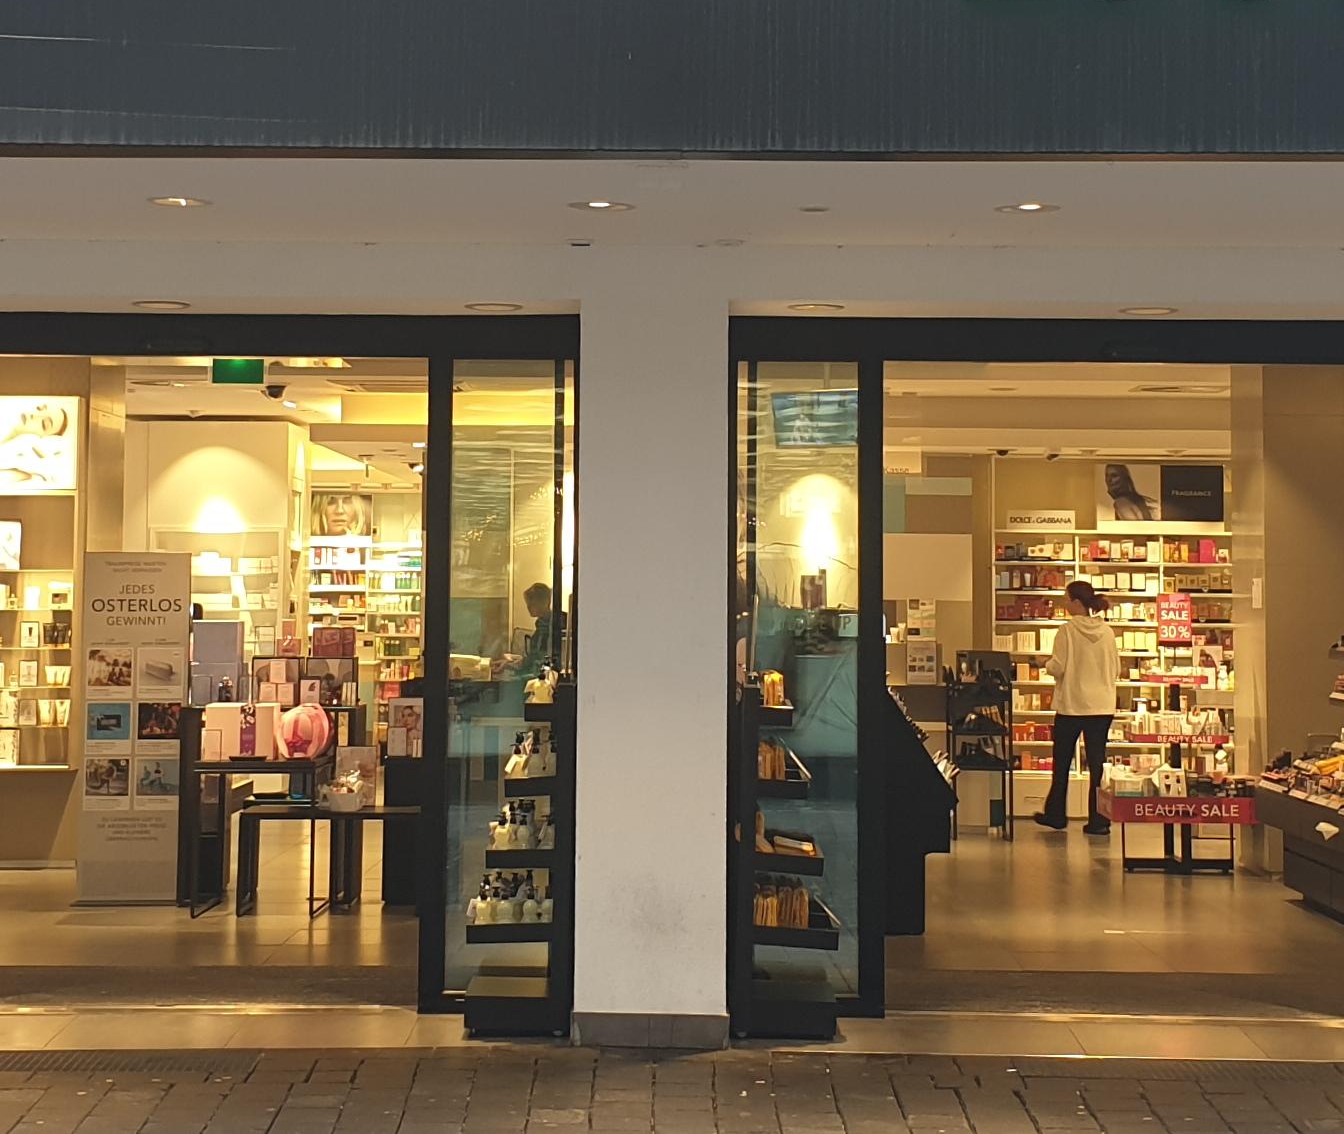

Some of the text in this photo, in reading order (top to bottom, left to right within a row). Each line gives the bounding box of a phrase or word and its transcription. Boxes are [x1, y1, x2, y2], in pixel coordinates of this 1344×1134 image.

[119, 584, 156, 595] JEDES
[91, 598, 182, 612] OSTERLOS
[1161, 610, 1189, 620] SALE
[106, 616, 167, 626] GEWINNT!
[1157, 735, 1213, 743] BEAUTY SALE
[1135, 803, 1239, 817] BEAUTY SALE
